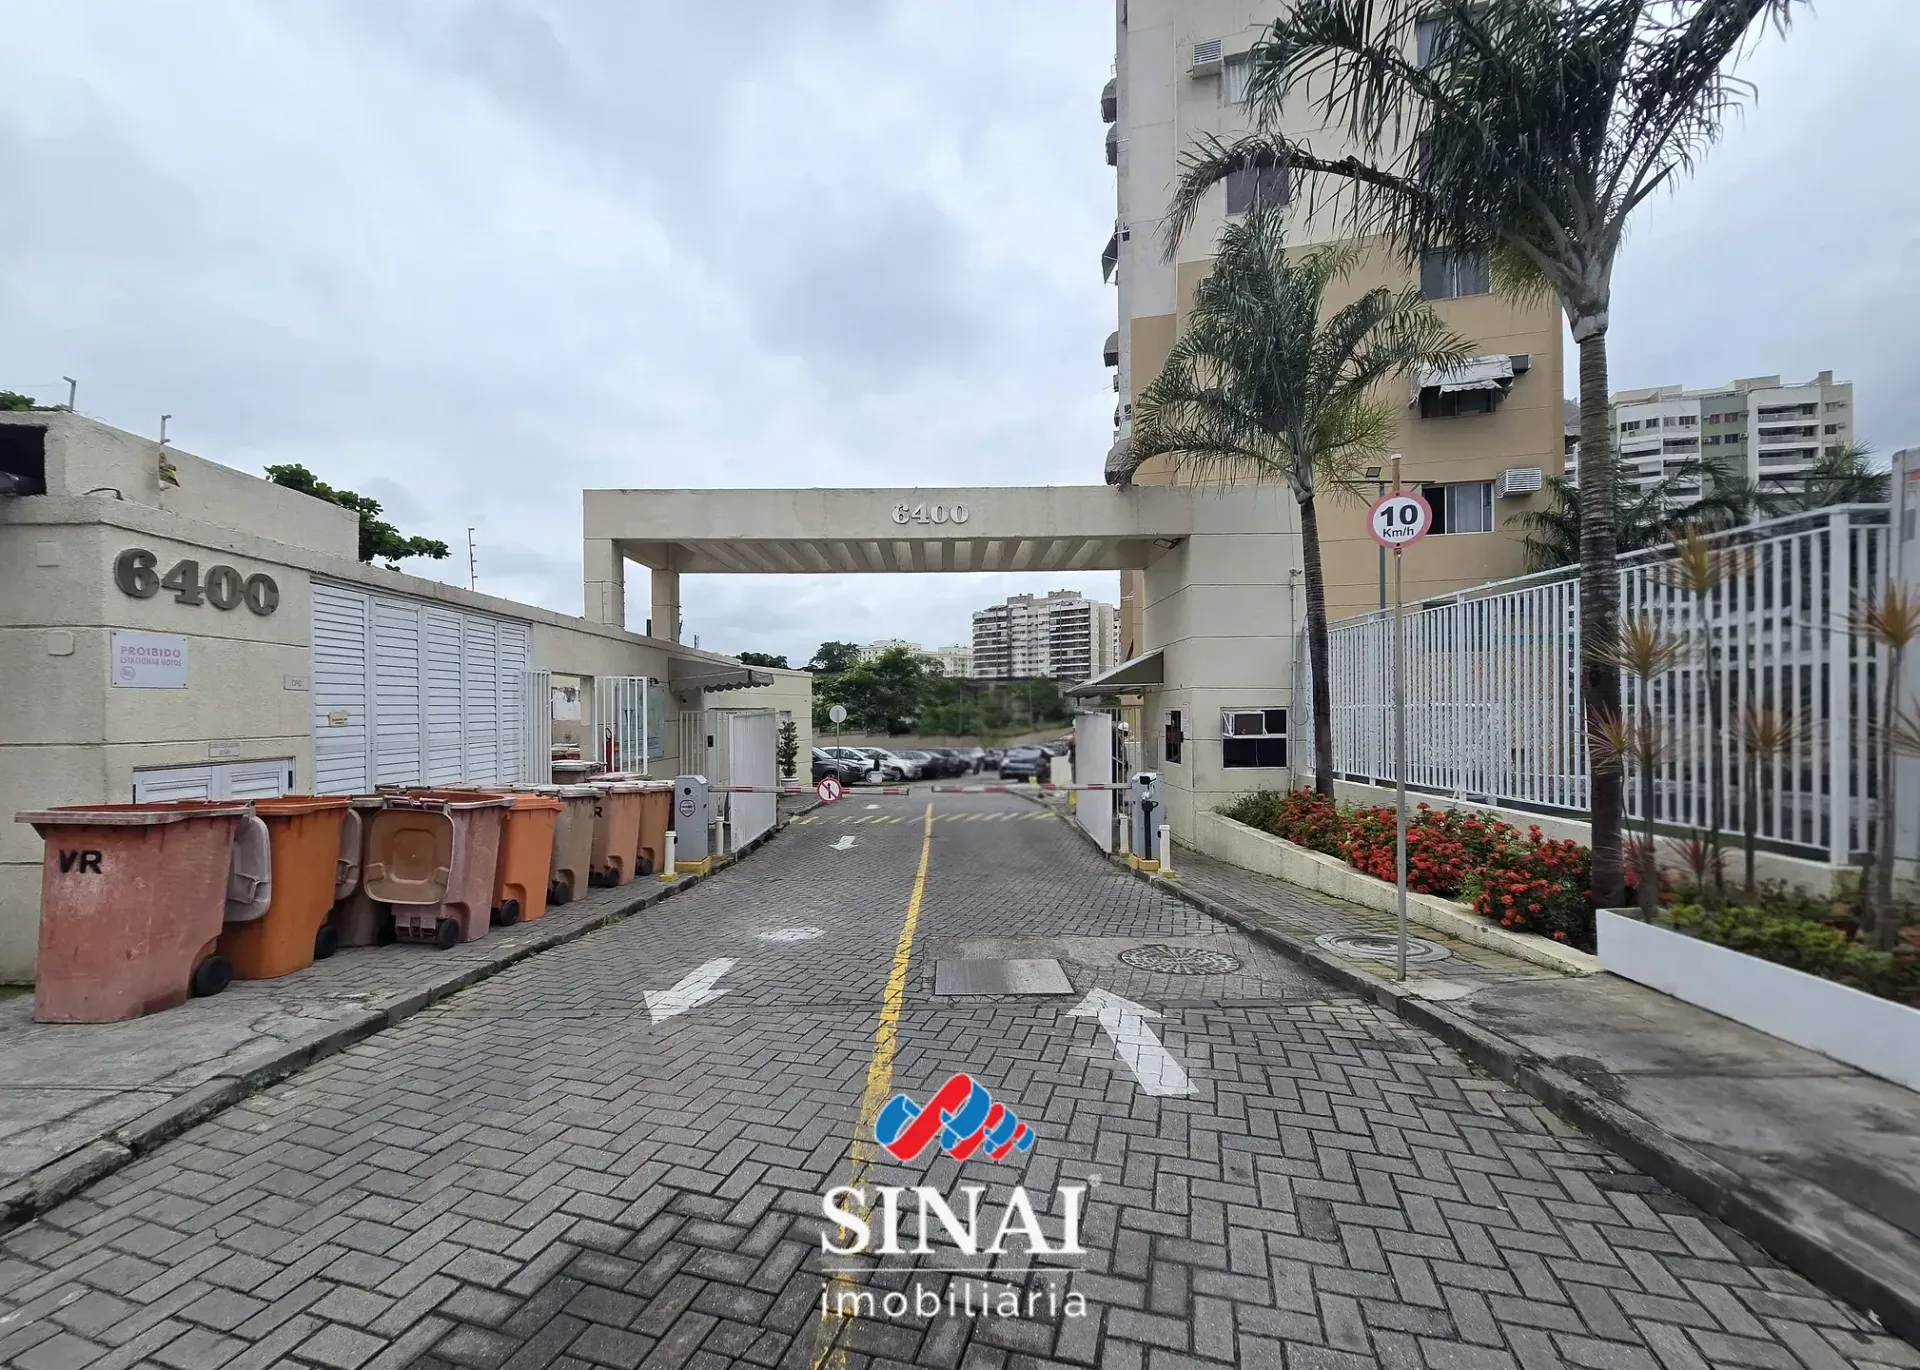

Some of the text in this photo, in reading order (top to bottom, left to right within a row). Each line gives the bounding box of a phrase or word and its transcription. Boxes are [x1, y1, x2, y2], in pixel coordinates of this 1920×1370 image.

[891, 503, 970, 525] 6400
[1380, 504, 1419, 527] 10
[1382, 526, 1415, 538] Km/h
[113, 548, 280, 616] 6400
[120, 645, 181, 658] PROIBIDO
[120, 657, 182, 667] ESTACIONAR MOTOS
[59, 849, 104, 875] VR
